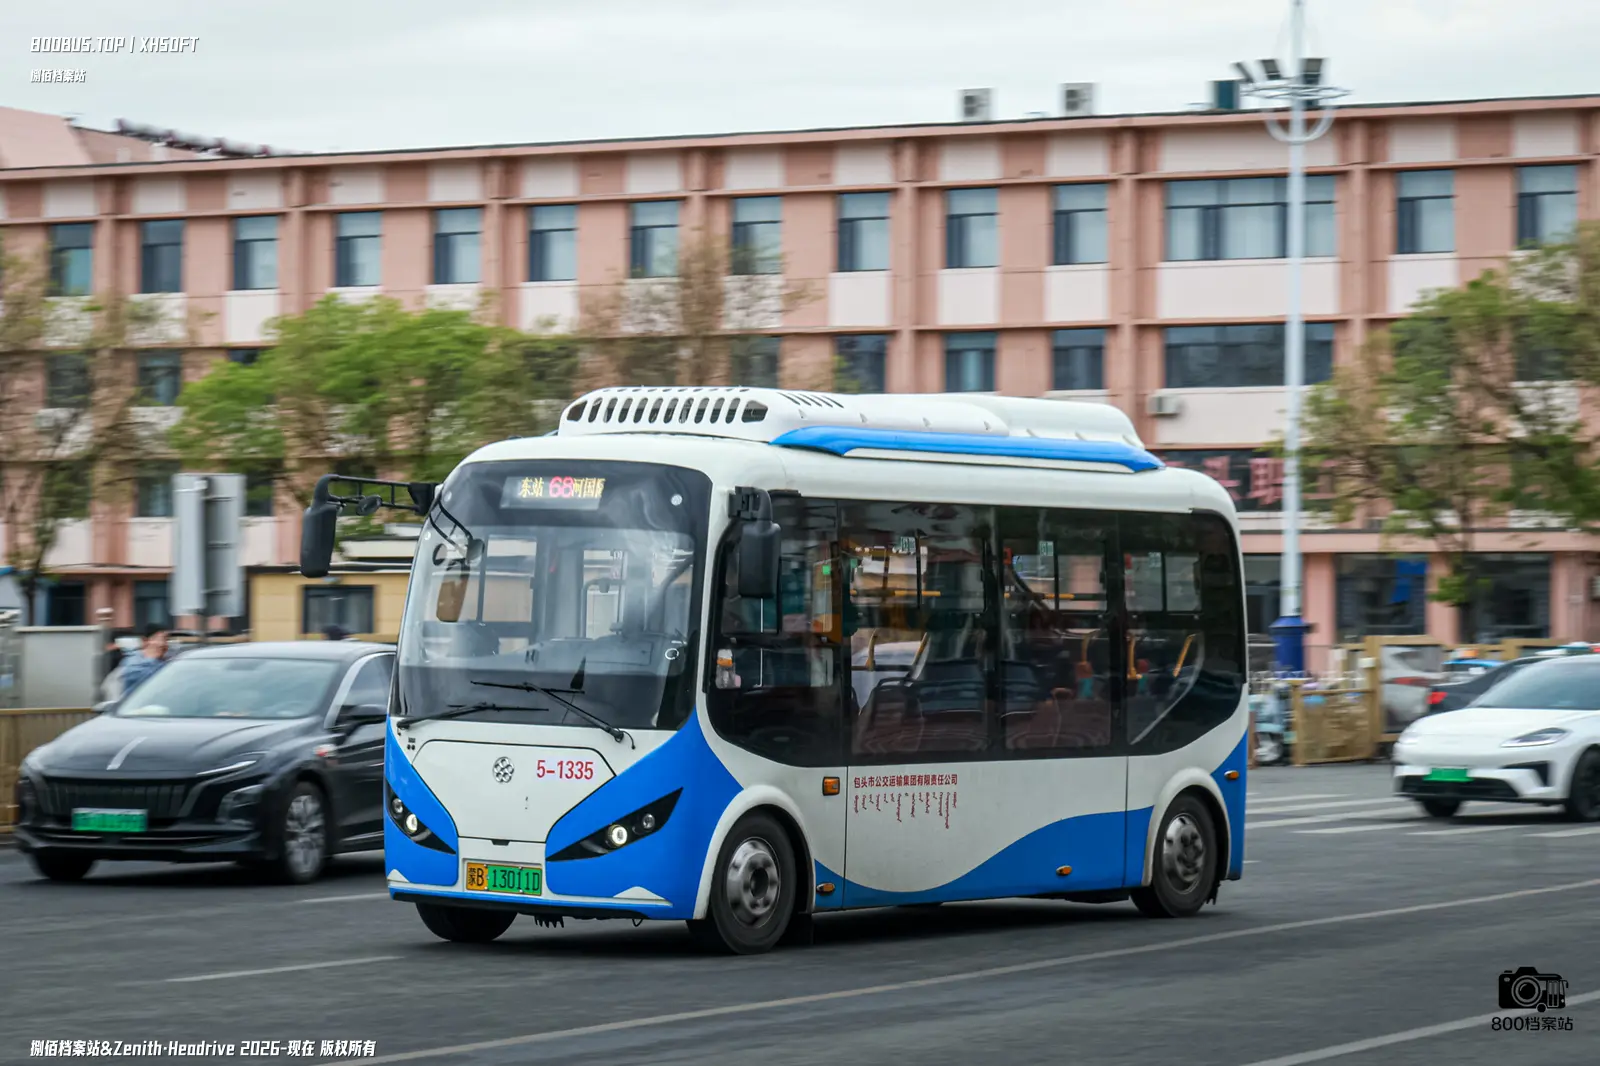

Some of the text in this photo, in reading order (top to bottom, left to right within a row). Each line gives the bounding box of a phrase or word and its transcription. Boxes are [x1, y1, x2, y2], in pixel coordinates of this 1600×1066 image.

[519, 476, 544, 498] 东站
[549, 475, 574, 498] 68
[536, 759, 594, 780] 5-1335
[853, 773, 958, 789] 包头市公交运输集团有限责任公司
